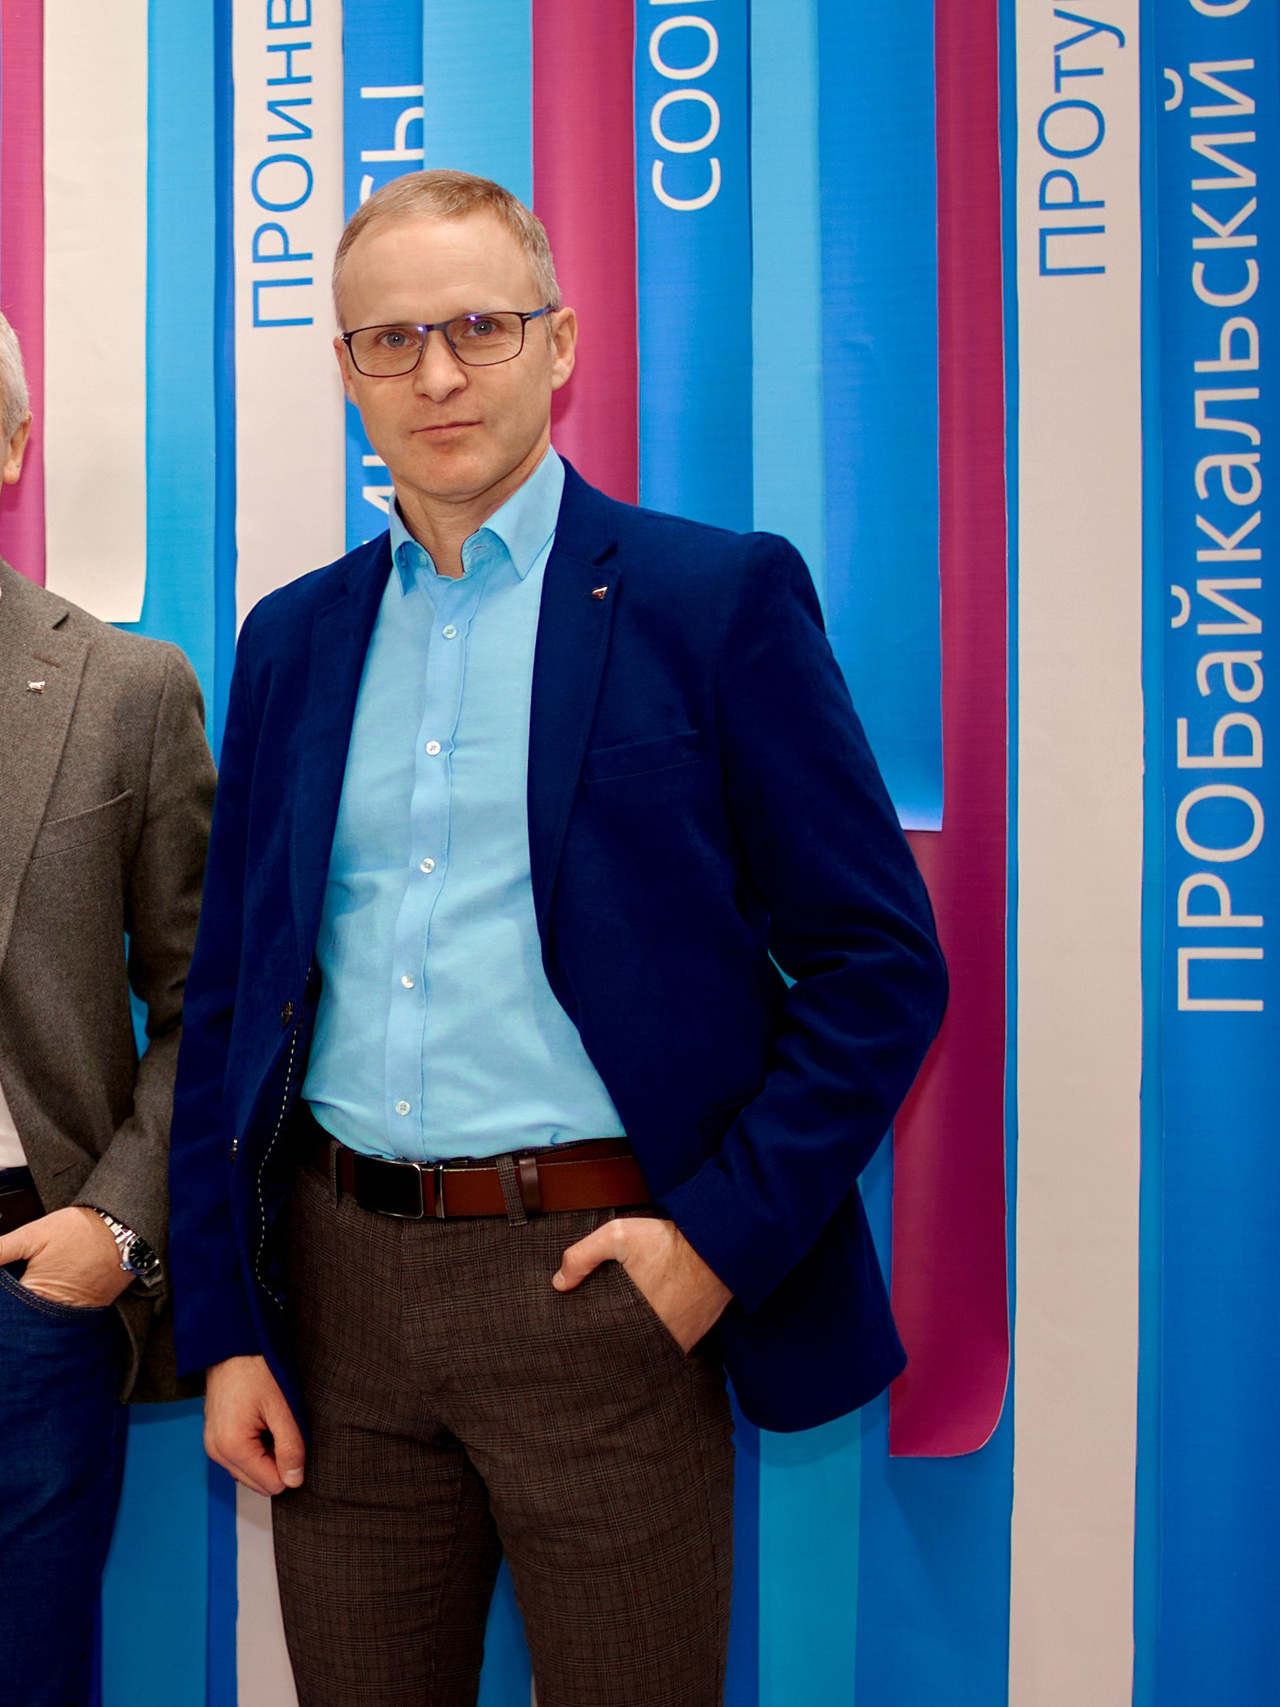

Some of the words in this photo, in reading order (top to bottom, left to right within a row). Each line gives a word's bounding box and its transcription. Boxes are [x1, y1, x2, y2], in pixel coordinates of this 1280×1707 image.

[251, 0, 314, 328] ПРОинв
[649, 0, 721, 212] СОО
[1037, 8, 1126, 277] ПРОту
[1164, 58, 1265, 1013] ПРОБайкальский
